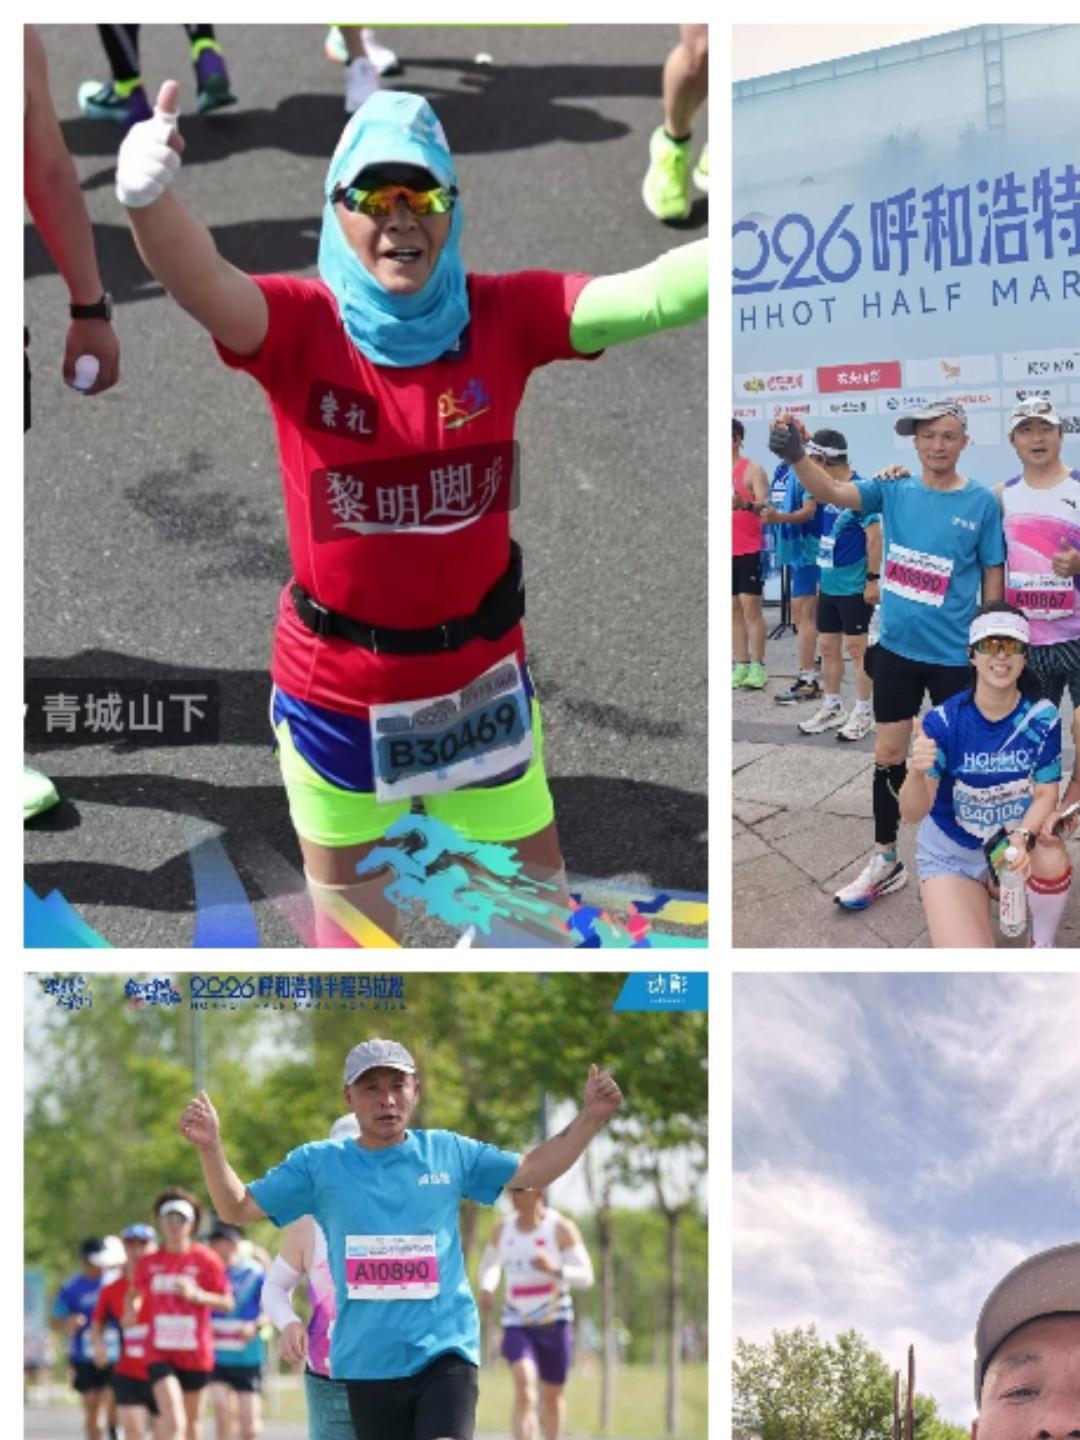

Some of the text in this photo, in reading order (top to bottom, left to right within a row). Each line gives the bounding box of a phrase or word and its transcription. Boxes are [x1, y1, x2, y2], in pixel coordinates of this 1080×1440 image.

[862, 282, 961, 319] HALF
[326, 457, 502, 526] 黎明脚步
[389, 702, 517, 769] B30469
[355, 1260, 429, 1280] A10890
